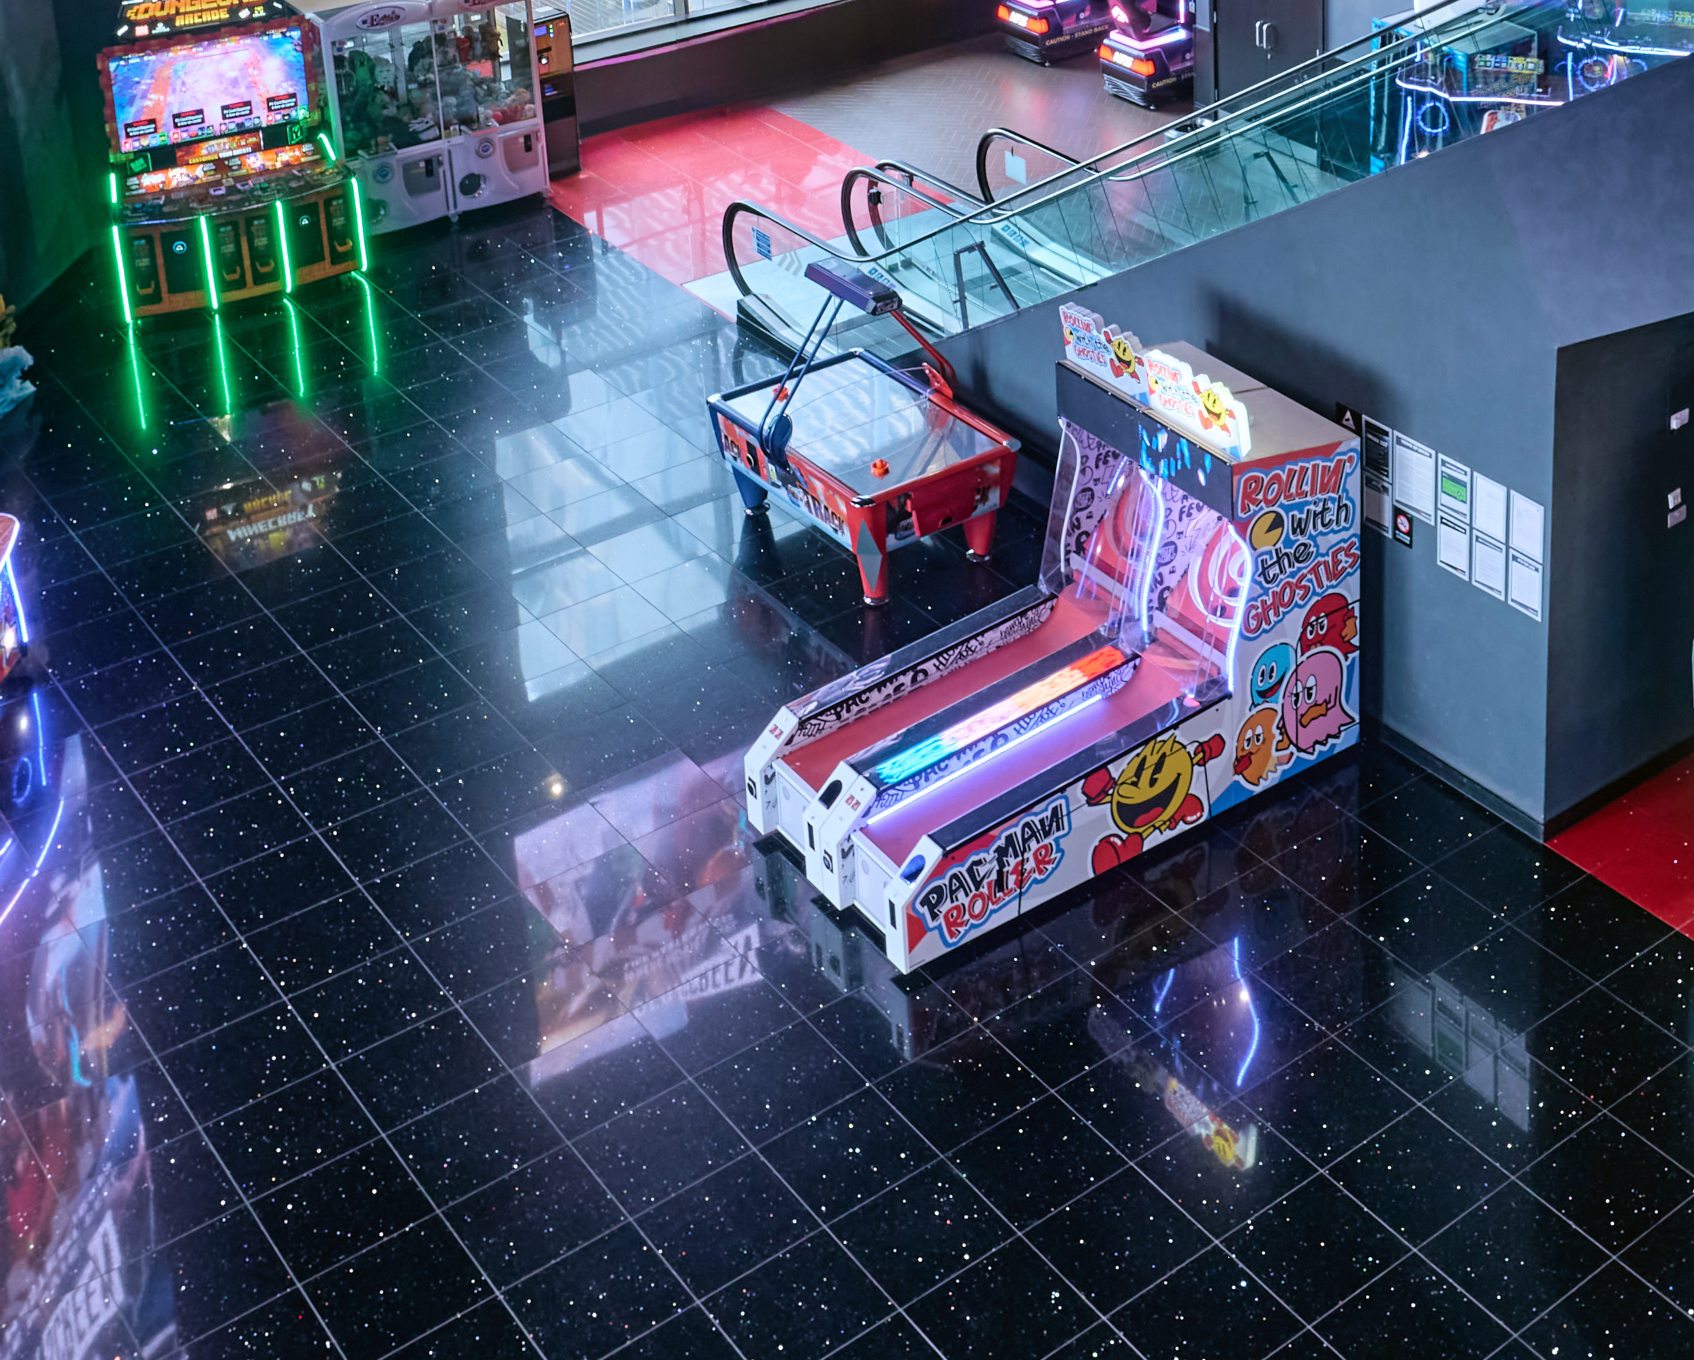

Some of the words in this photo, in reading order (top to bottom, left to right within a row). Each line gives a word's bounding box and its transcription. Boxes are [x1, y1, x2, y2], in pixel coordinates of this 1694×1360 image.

[175, 8, 230, 27] ARCADE
[1239, 453, 1356, 516] ROLLIN'
[1290, 494, 1351, 537] with
[1242, 539, 1361, 636] GHOSTIES
[1257, 540, 1315, 586] the
[919, 802, 1065, 924] PAC-MAN
[942, 842, 1057, 940] ROLLER
